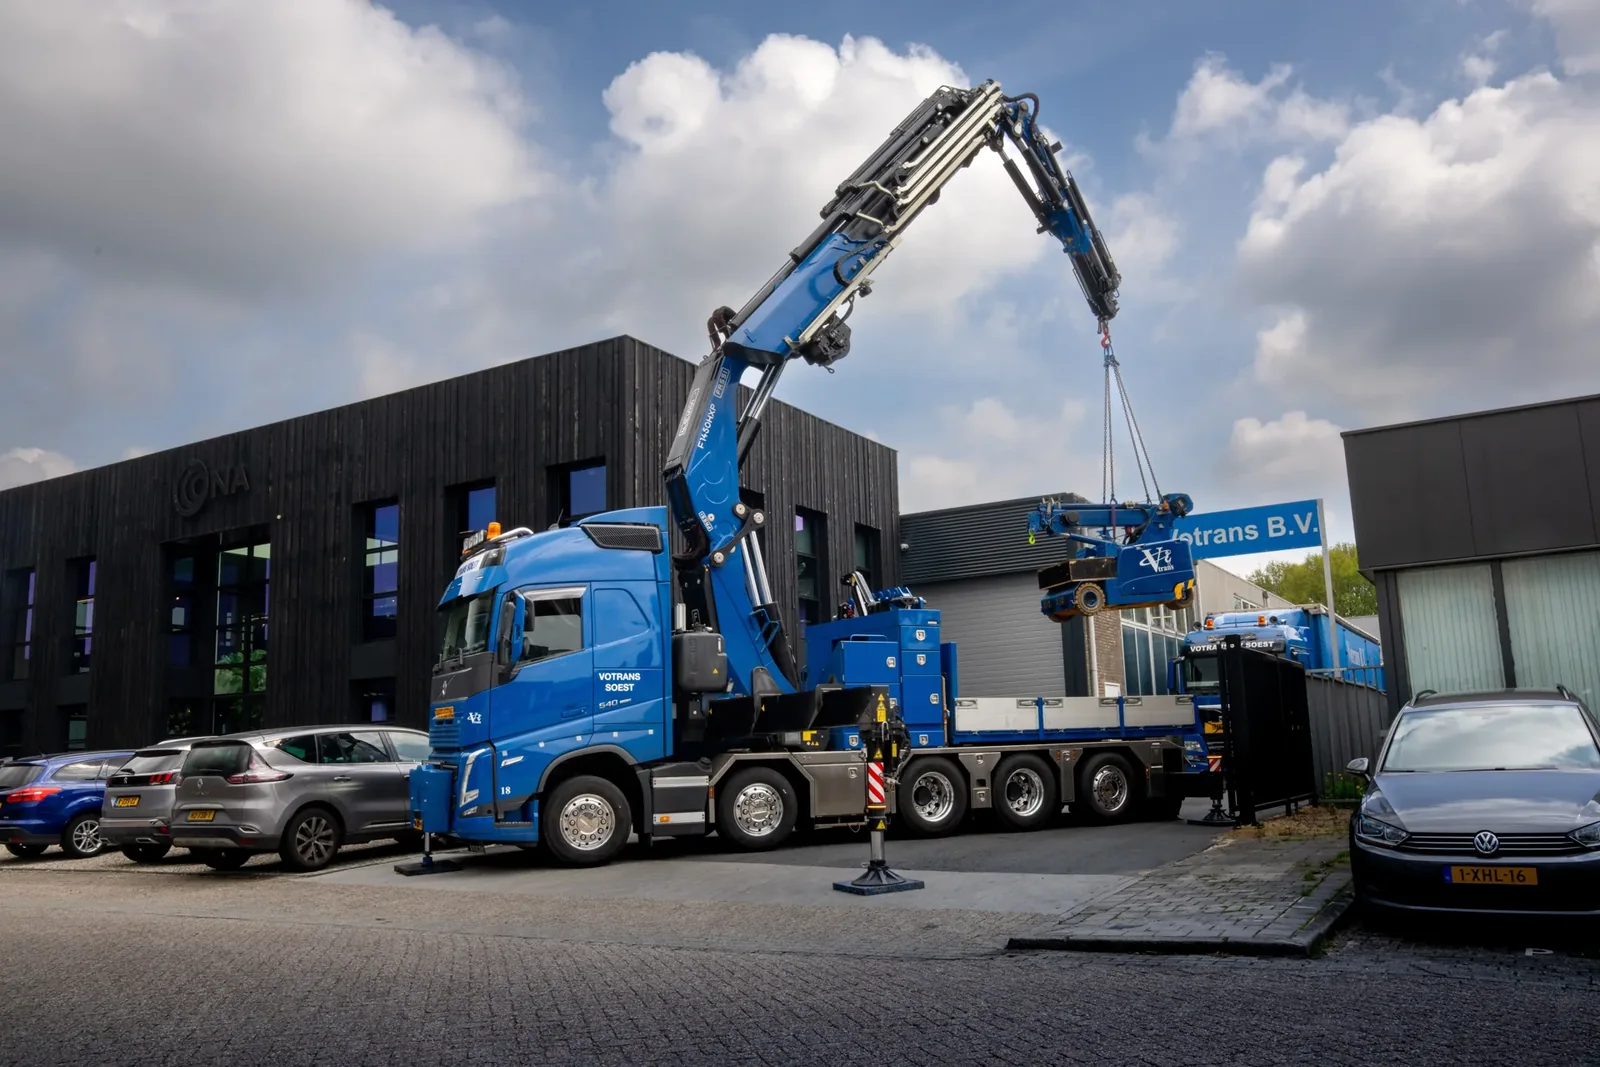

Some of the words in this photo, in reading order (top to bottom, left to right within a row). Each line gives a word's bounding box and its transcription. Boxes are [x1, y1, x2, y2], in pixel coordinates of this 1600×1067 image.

[697, 403, 717, 449] F1450HXP
[1267, 512, 1318, 538] B.V.
[598, 672, 641, 681] VOTRANS
[605, 683, 635, 692] SOEST
[599, 699, 618, 709] 540
[501, 786, 511, 795] 18
[1459, 868, 1526, 883] 1-XHL-16
